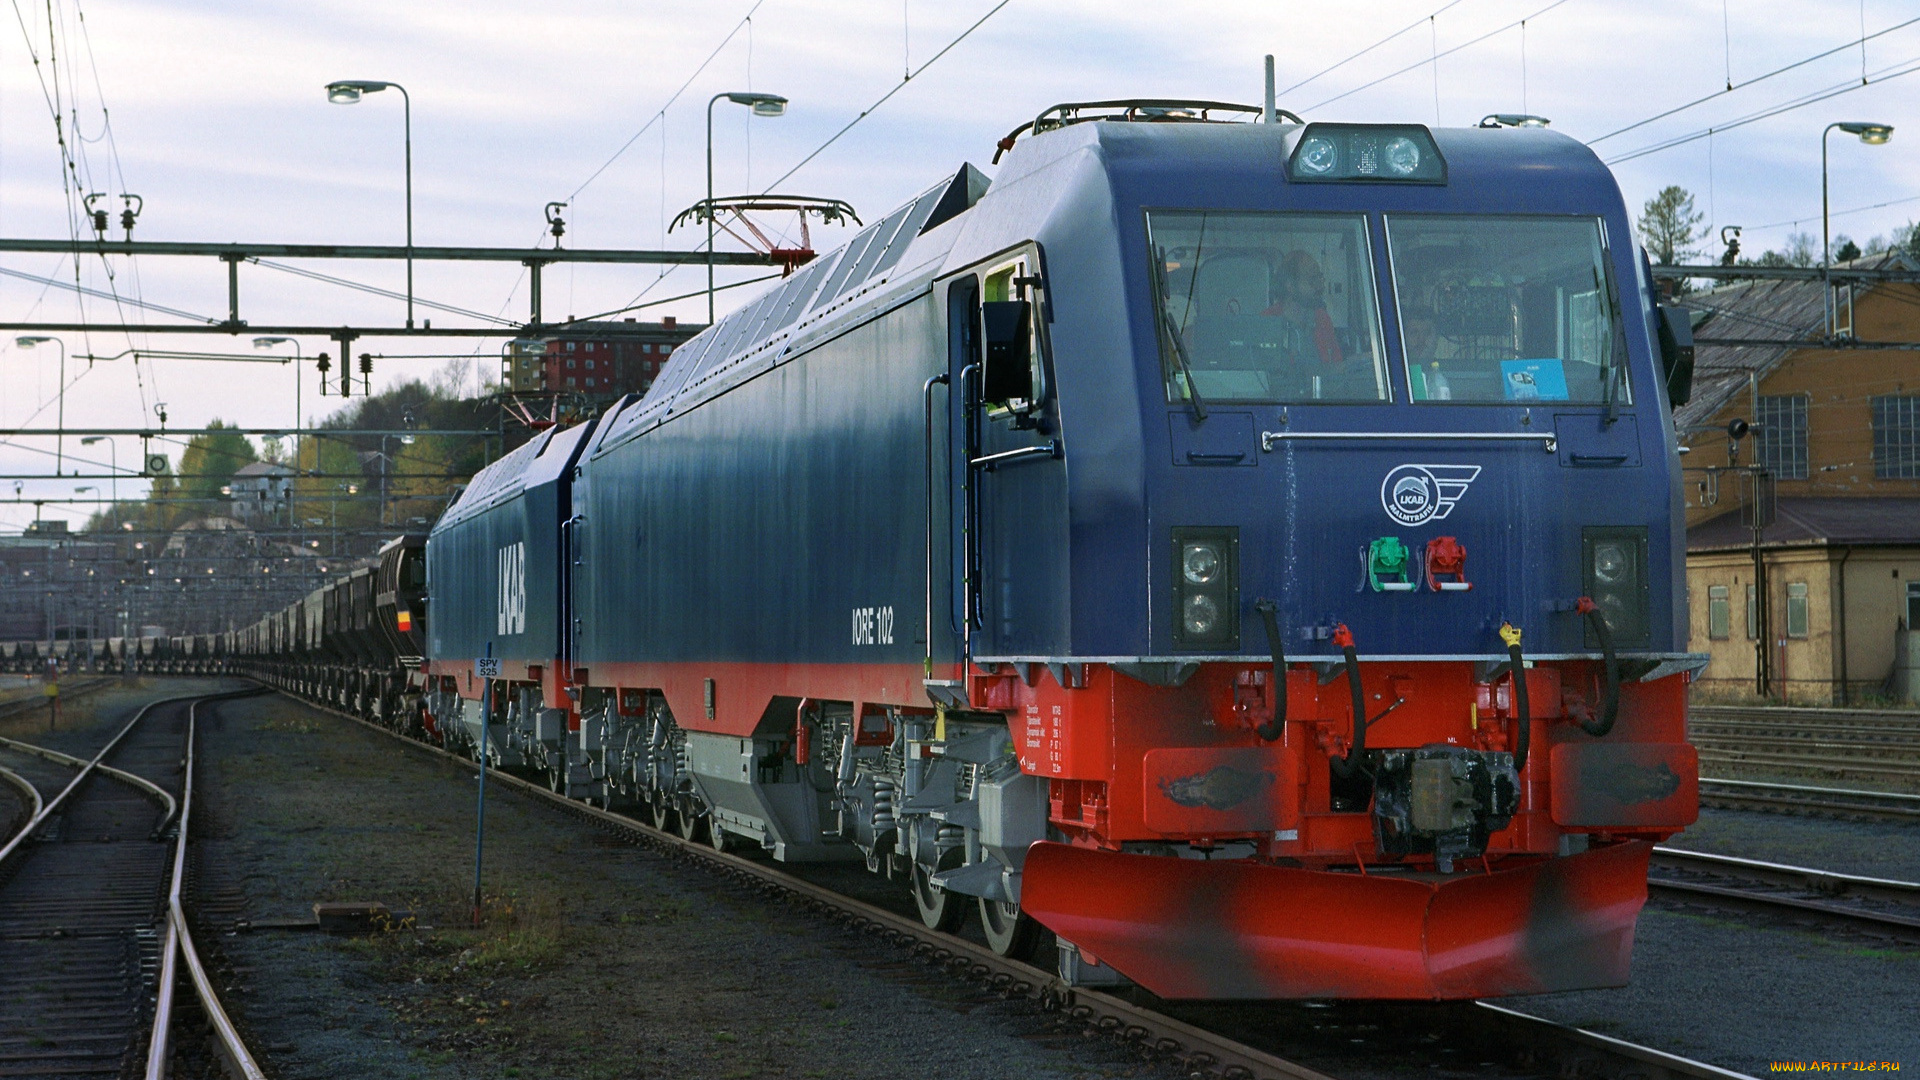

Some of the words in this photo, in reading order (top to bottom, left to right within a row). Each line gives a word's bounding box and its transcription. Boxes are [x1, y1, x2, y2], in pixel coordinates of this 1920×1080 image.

[1400, 495, 1424, 505] LKAB
[1388, 503, 1434, 522] MALMTRAFIK
[498, 541, 526, 636] LKAB
[852, 607, 874, 646] IORE
[876, 605, 894, 645] 102
[479, 659, 498, 668] SPV
[480, 668, 497, 677] 525
